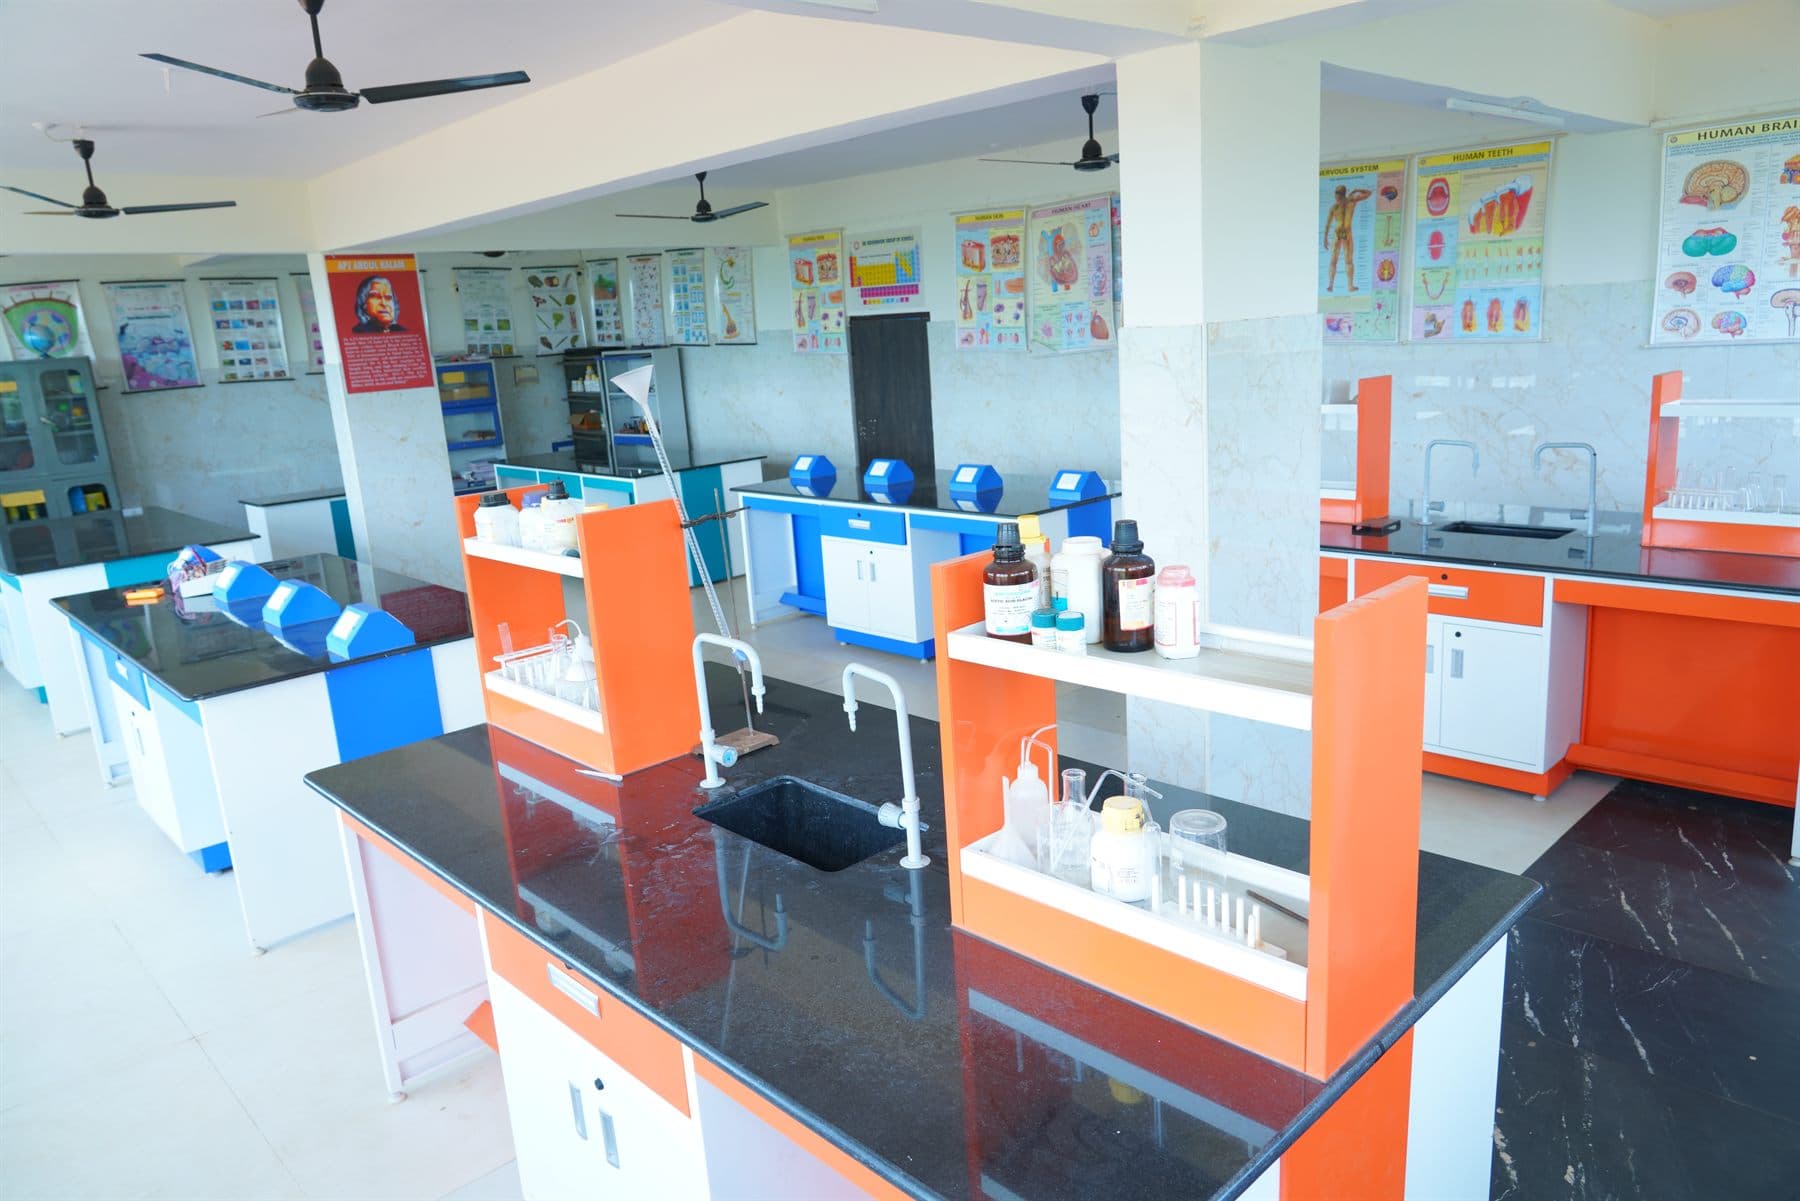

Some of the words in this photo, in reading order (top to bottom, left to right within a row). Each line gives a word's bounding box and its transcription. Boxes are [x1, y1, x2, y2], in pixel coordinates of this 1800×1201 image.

[1697, 125, 1755, 141] HUMAN
[1452, 151, 1485, 162] HUMAN
[1488, 148, 1513, 158] TEETH
[1351, 164, 1379, 173] SYSTEM
[1052, 206, 1073, 214] HUMAN
